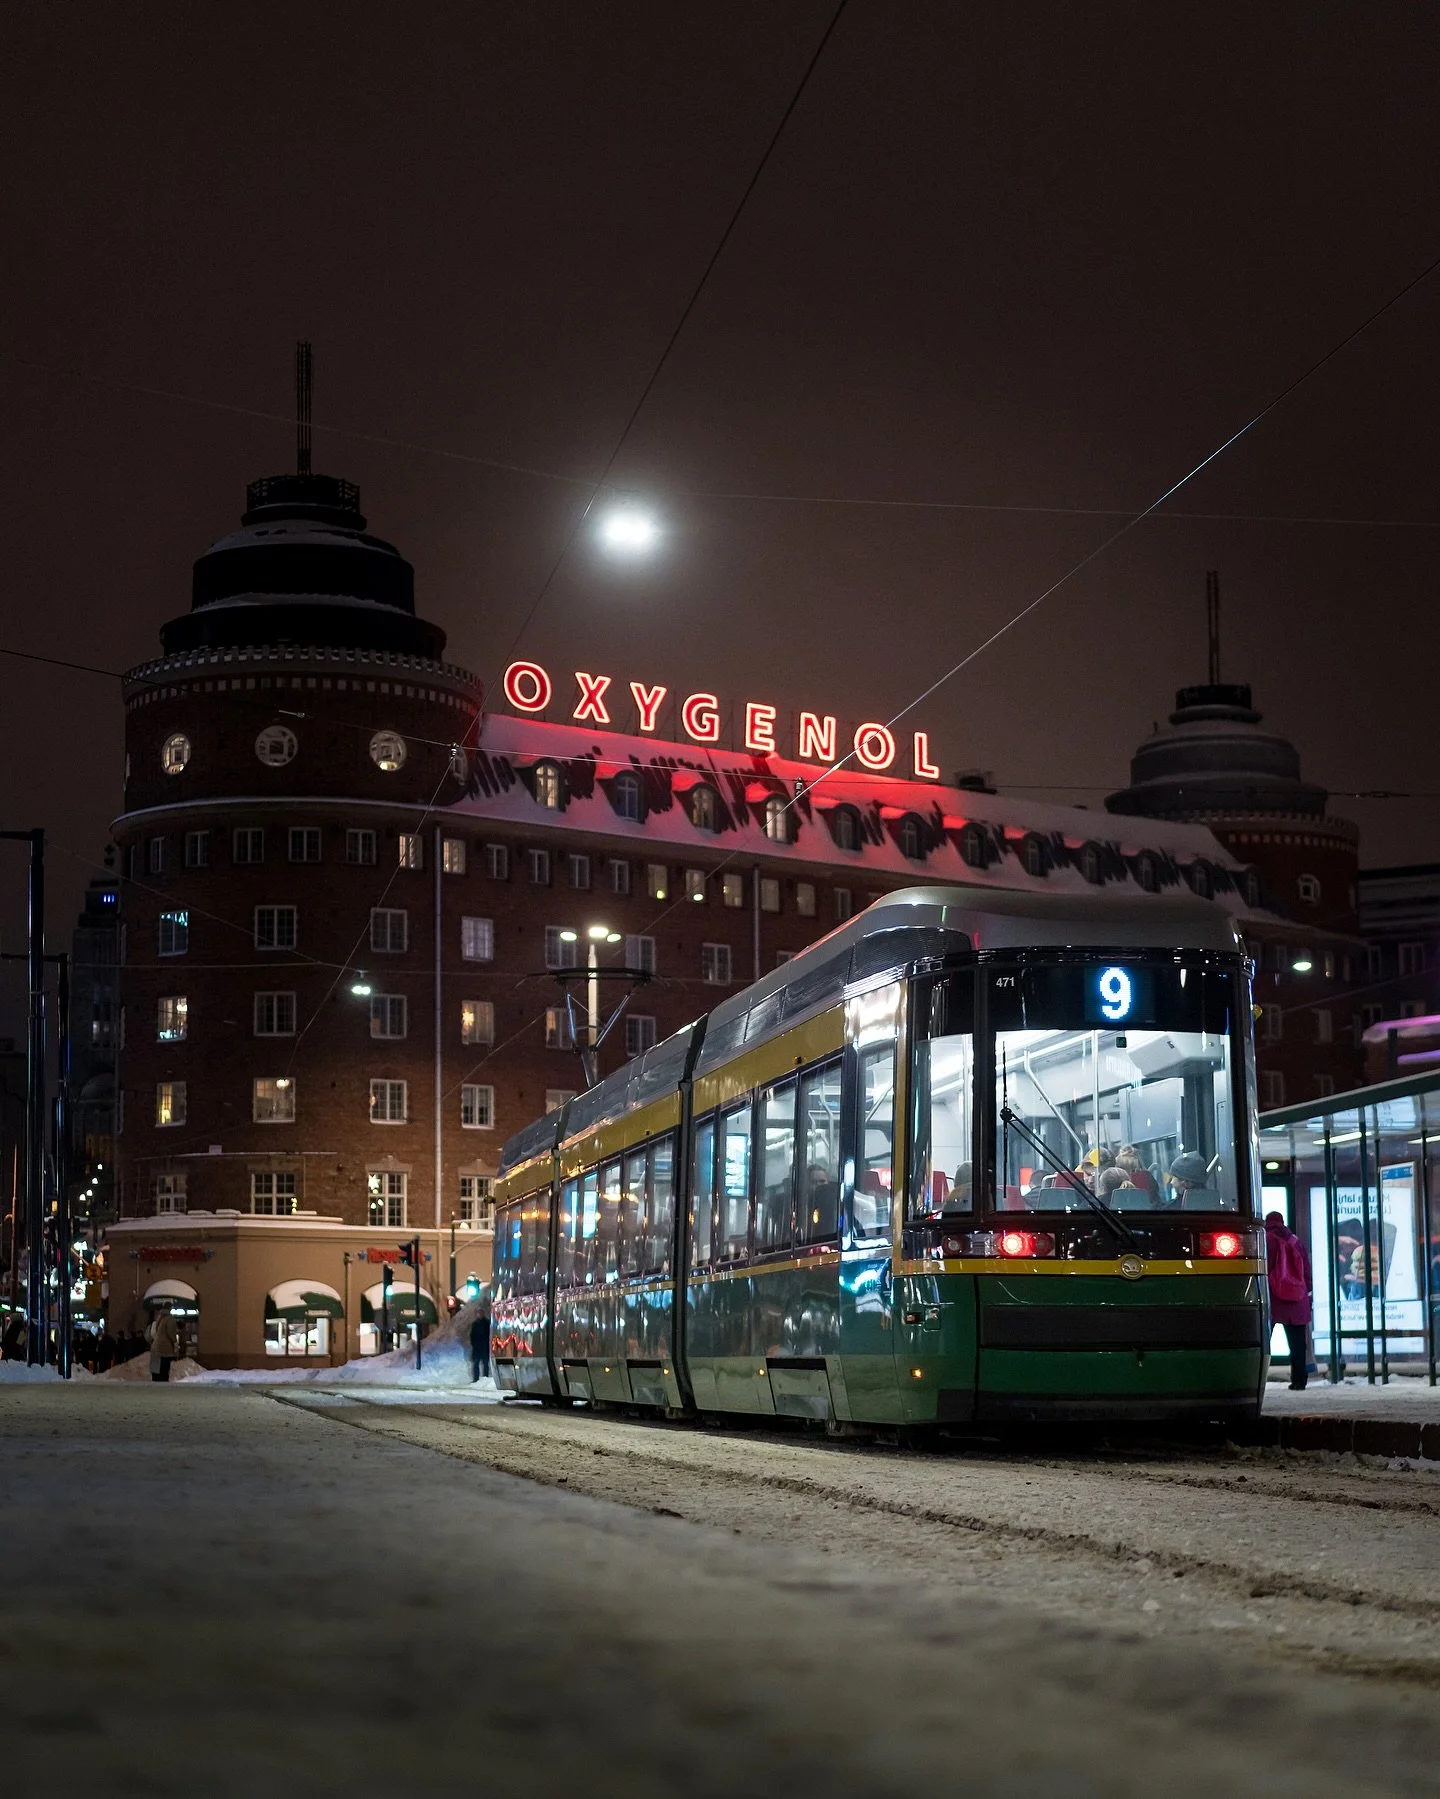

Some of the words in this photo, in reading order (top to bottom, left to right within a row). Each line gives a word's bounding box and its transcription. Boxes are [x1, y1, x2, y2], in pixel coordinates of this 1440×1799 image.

[503, 661, 939, 779] OXYGENOL
[995, 977, 1015, 988] 471
[1099, 966, 1131, 1019] 9
